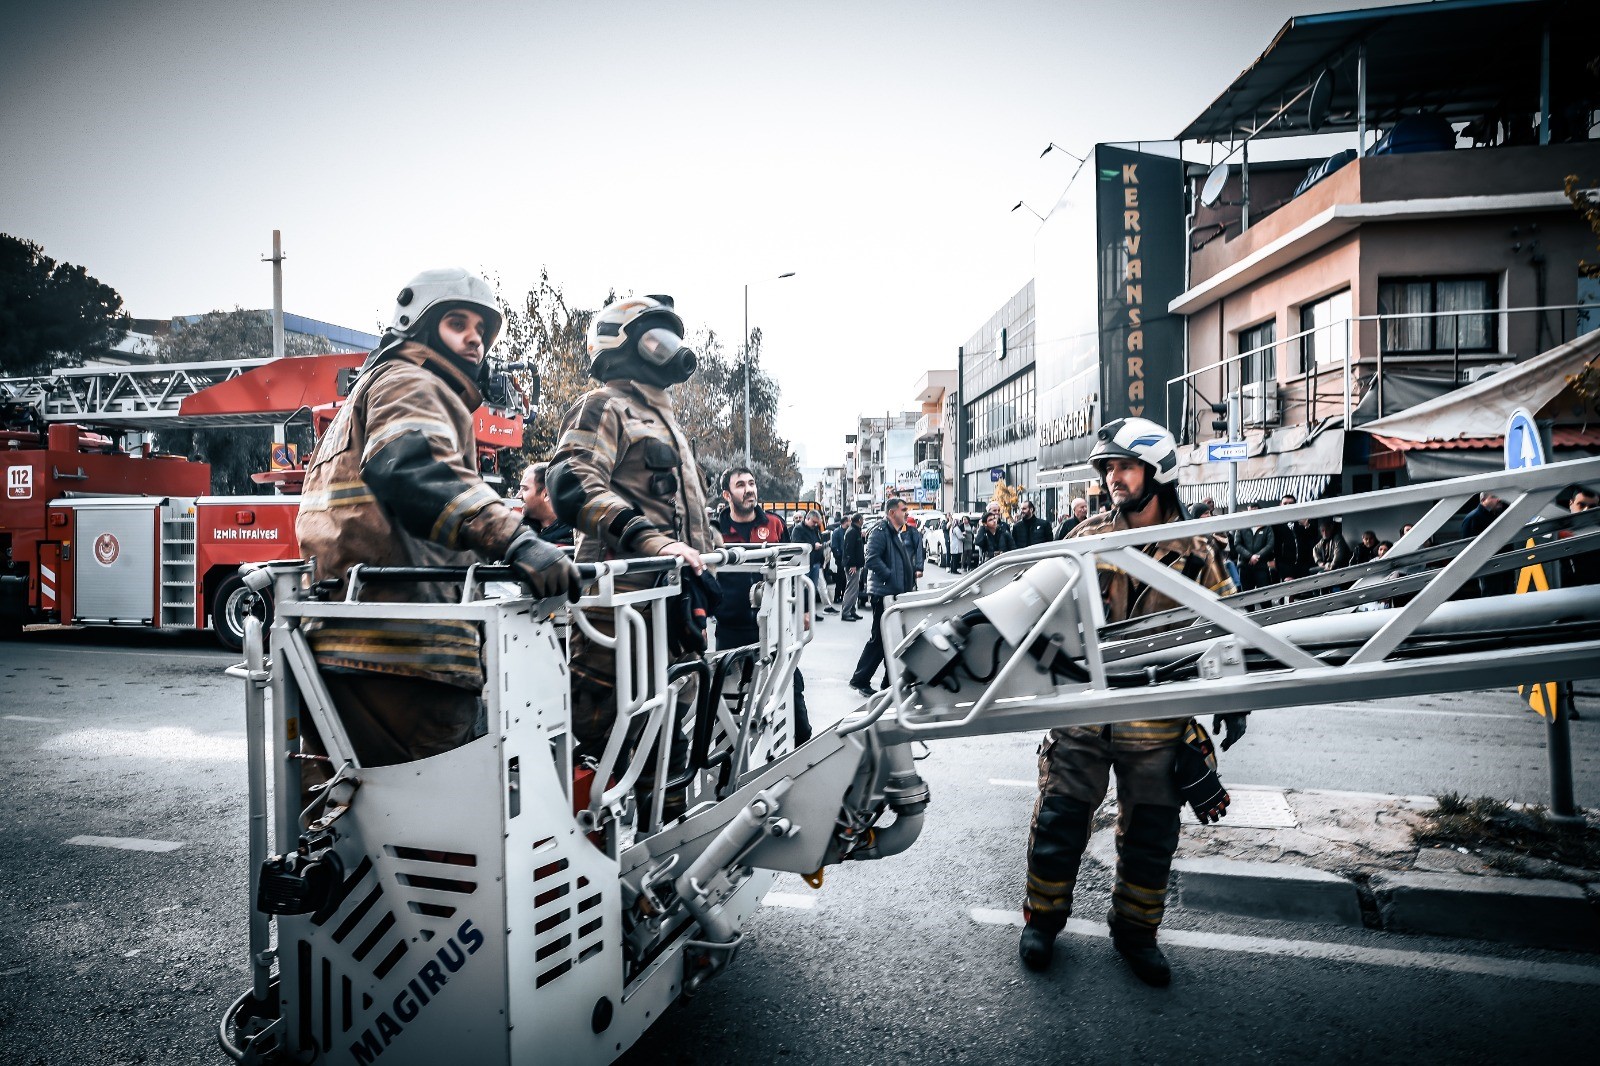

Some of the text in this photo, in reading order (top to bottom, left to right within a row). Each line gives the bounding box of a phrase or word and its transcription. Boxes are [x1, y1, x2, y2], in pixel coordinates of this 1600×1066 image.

[1040, 404, 1094, 447] KERVANSARAY
[11, 469, 29, 485] 112
[213, 527, 278, 540] İZMİR İTFAİYESİ
[349, 918, 485, 1066] MAGIRUS
